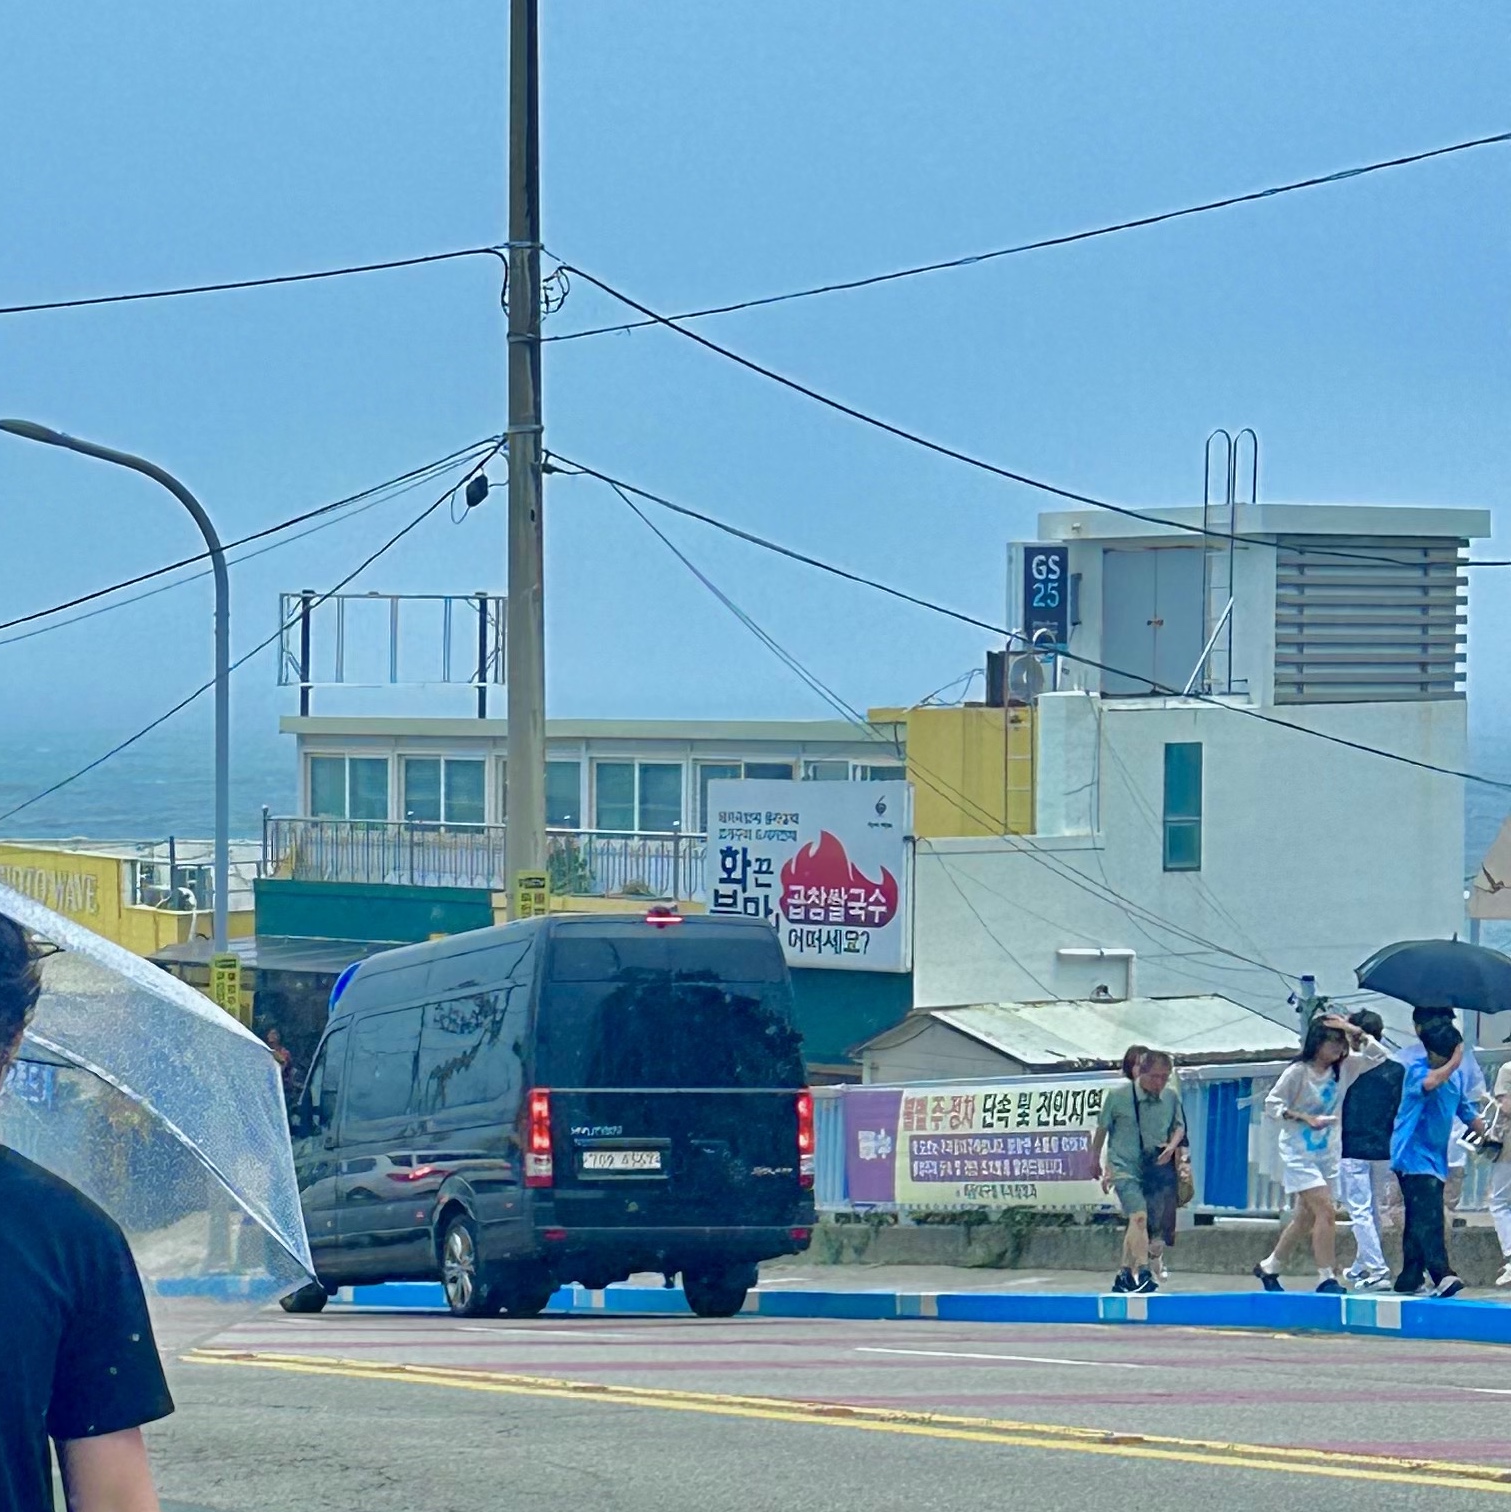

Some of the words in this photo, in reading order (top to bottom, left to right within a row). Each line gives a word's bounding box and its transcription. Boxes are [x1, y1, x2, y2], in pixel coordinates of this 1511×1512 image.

[1032, 554, 1061, 580] GS
[1032, 582, 1060, 608] 25
[982, 1093, 1011, 1128] 단속
